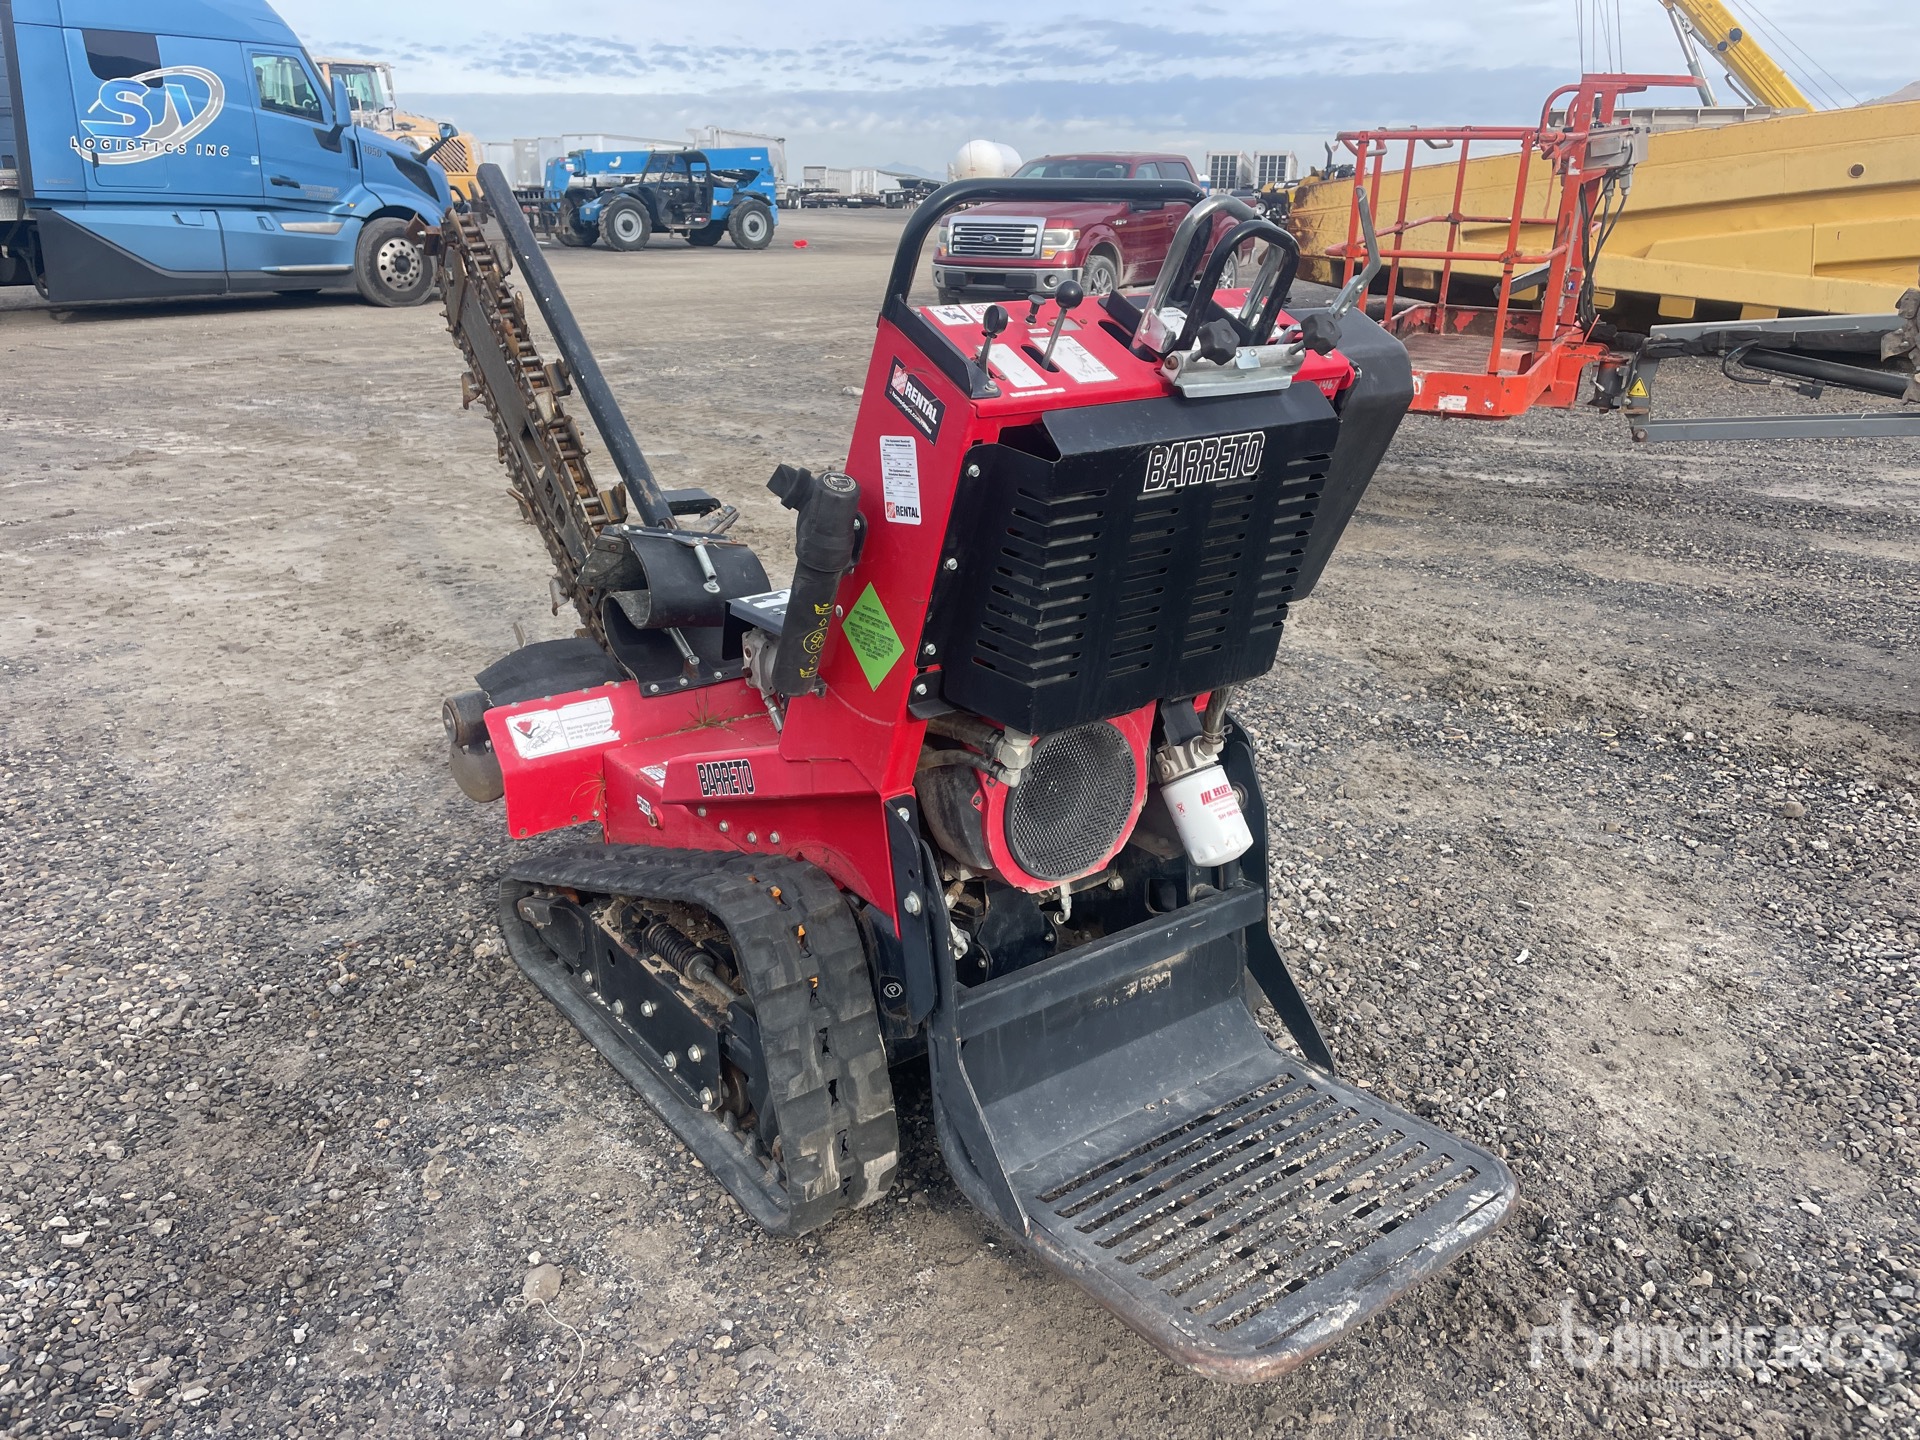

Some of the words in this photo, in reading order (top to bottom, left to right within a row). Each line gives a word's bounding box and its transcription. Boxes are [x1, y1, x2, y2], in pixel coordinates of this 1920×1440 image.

[70, 138, 186, 154] LOGISTICS
[197, 144, 230, 156] INC
[904, 380, 937, 425] RENTAL
[1143, 430, 1266, 493] BARRETO
[895, 505, 920, 519] RENTAL
[696, 758, 757, 798] BARRETO
